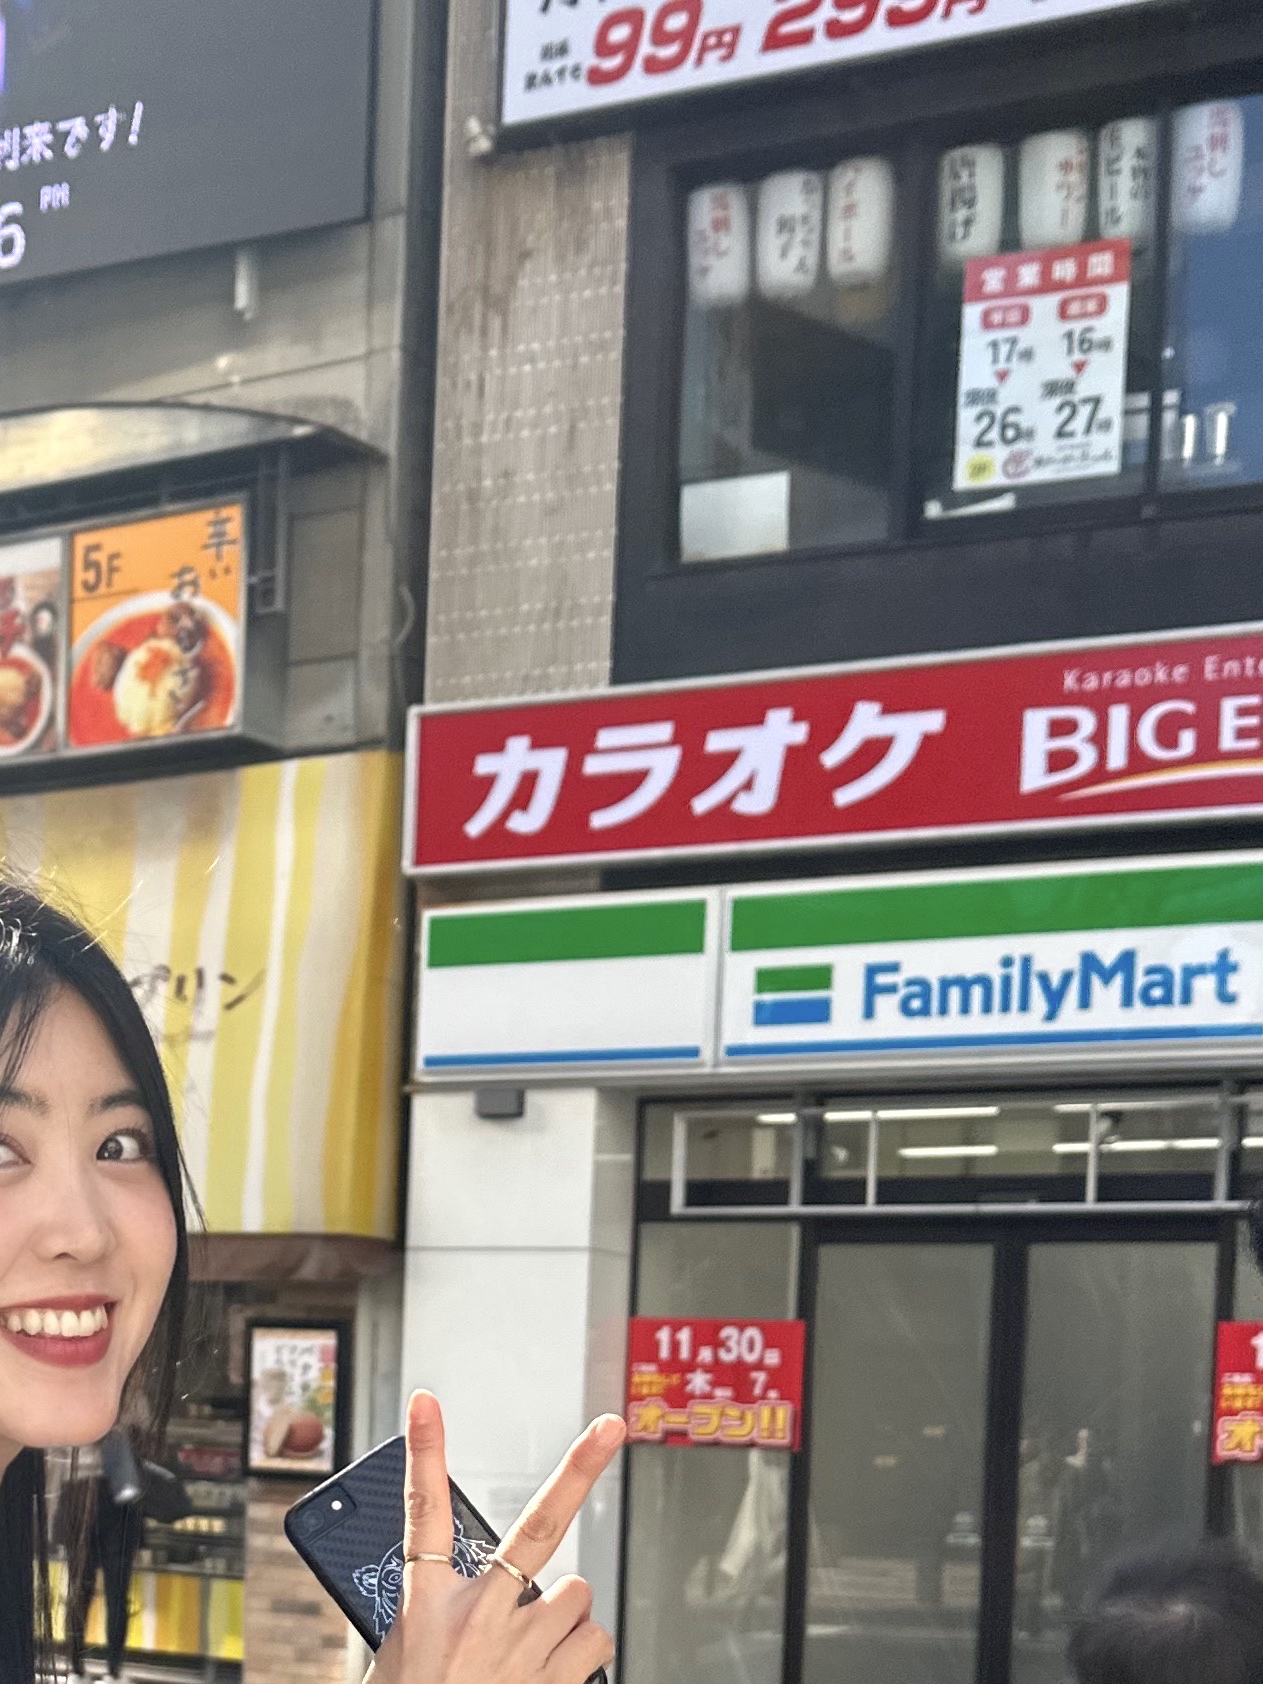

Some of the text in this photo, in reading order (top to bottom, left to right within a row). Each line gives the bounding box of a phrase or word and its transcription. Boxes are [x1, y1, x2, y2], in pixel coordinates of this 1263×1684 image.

[585, 0, 741, 86] 99円
[40, 181, 70, 214] PM
[81, 544, 122, 594] 5F
[1063, 661, 1189, 694] Karaoke
[463, 700, 947, 839] カラオケ
[1019, 698, 1197, 795] BIG
[862, 947, 1240, 1022] FamilyMart
